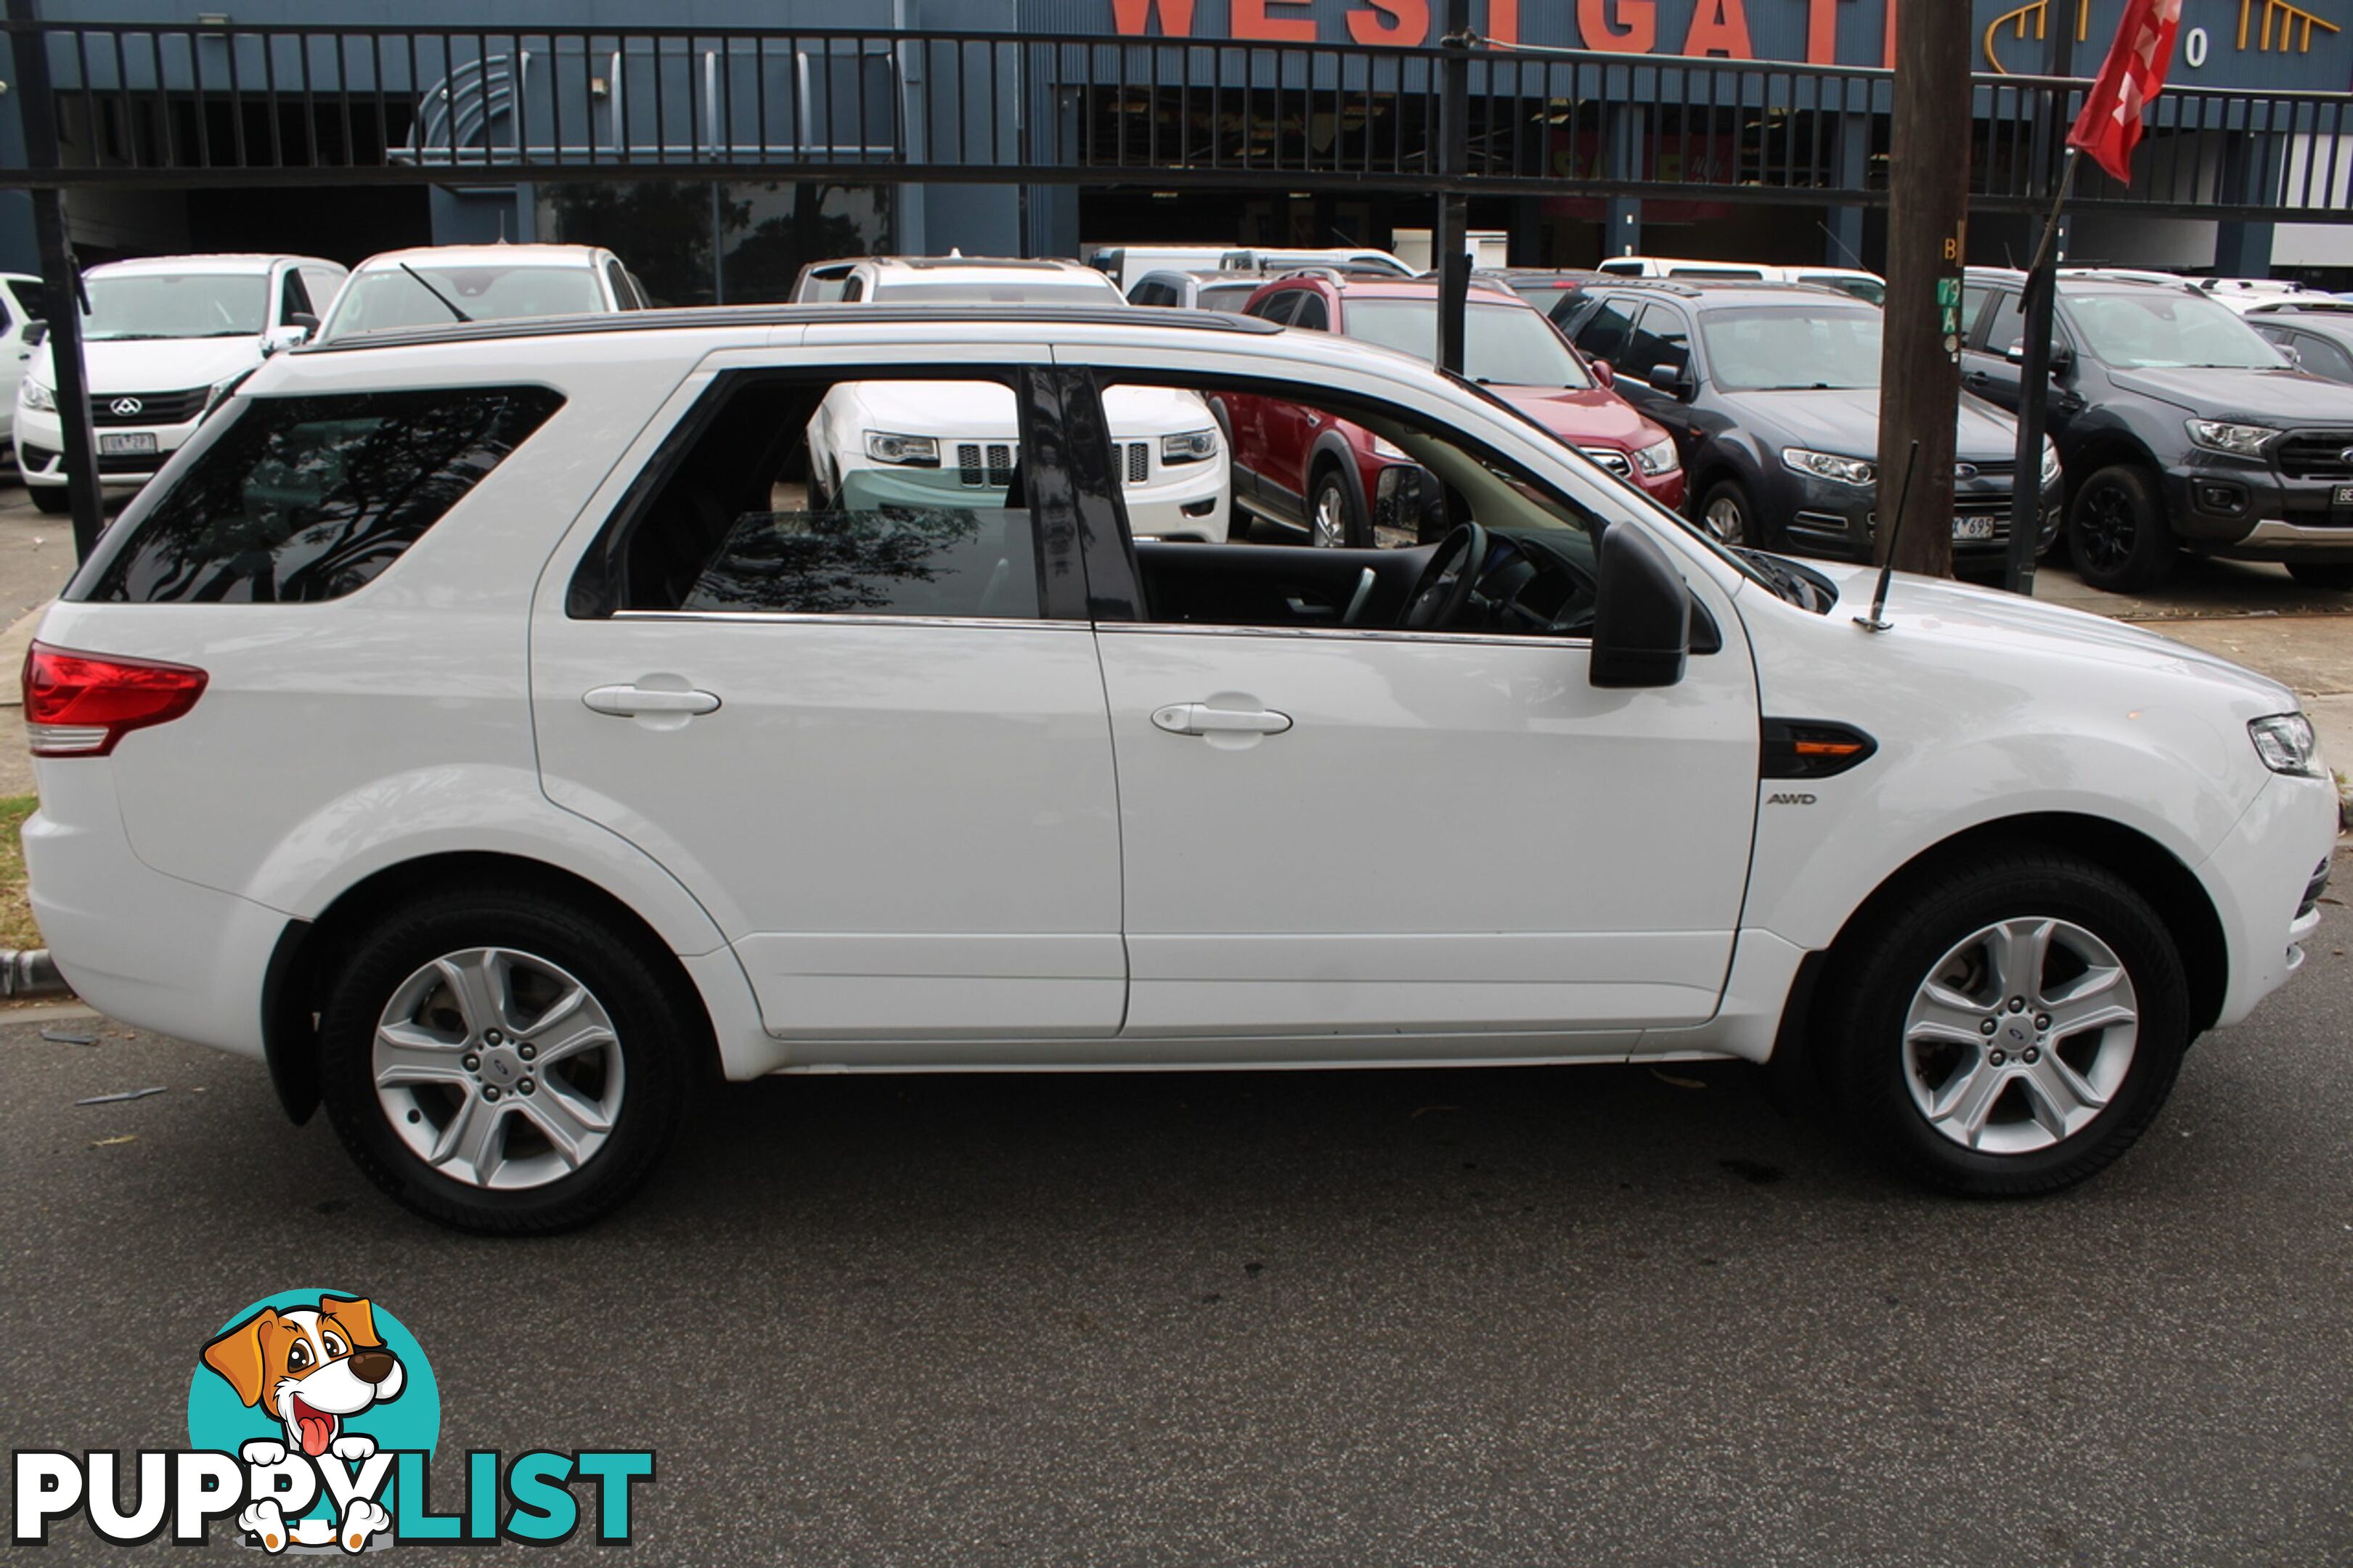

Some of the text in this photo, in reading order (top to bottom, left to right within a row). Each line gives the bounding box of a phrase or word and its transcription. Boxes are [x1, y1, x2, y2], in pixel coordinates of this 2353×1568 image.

[1944, 238, 1957, 261] B
[1943, 307, 1956, 332] A
[1968, 518, 1992, 534] 695
[1766, 793, 1817, 804] AWD
